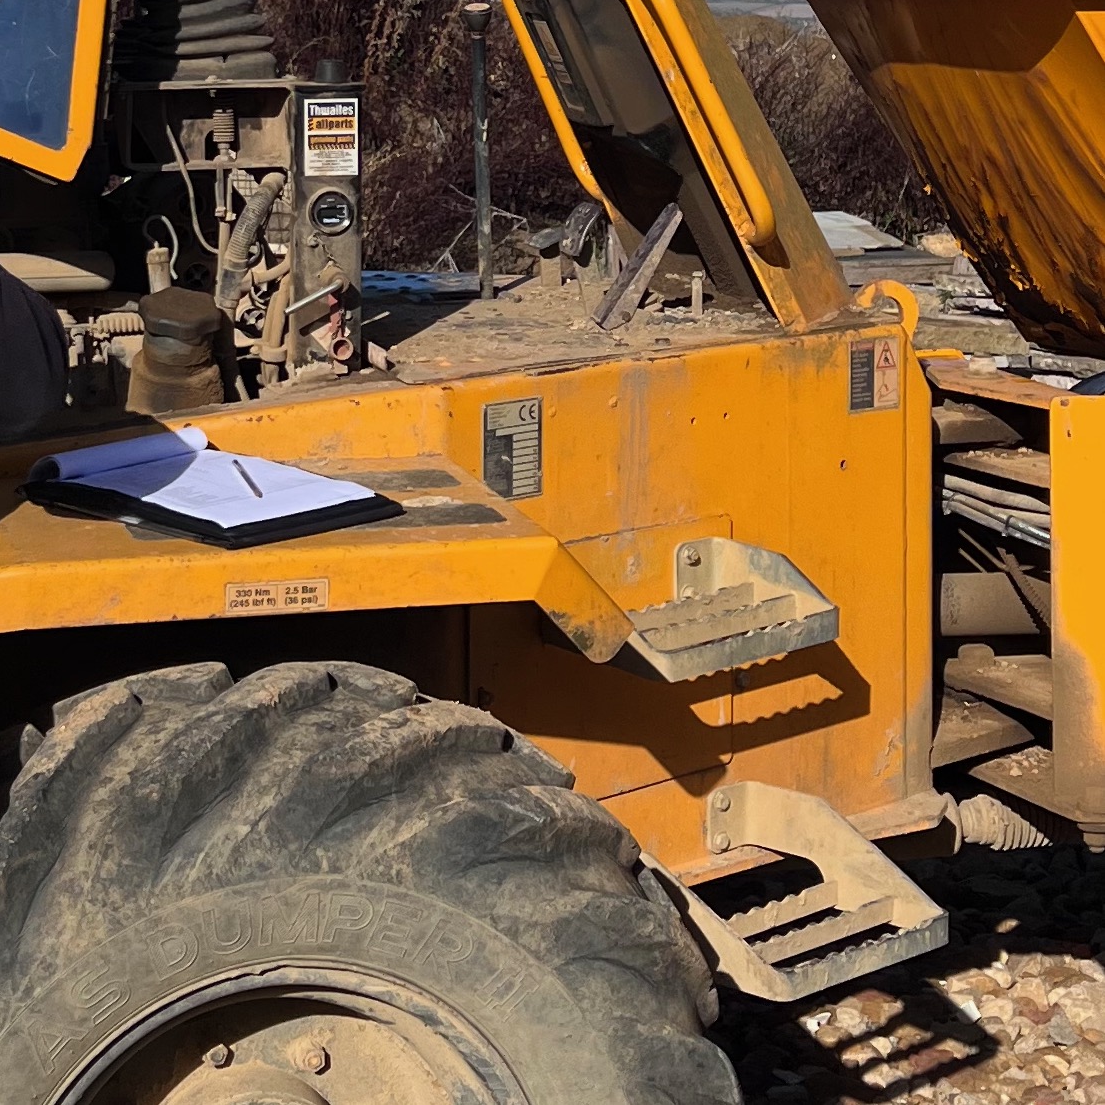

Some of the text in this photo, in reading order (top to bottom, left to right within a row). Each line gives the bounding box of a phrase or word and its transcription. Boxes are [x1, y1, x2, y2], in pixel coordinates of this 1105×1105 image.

[309, 104, 354, 116] Thwaites
[315, 118, 354, 131] allparts
[255, 588, 270, 597] Nm
[285, 586, 317, 594] 2.5 Bar
[285, 596, 298, 606] (36
[144, 893, 473, 981] DUMPER
